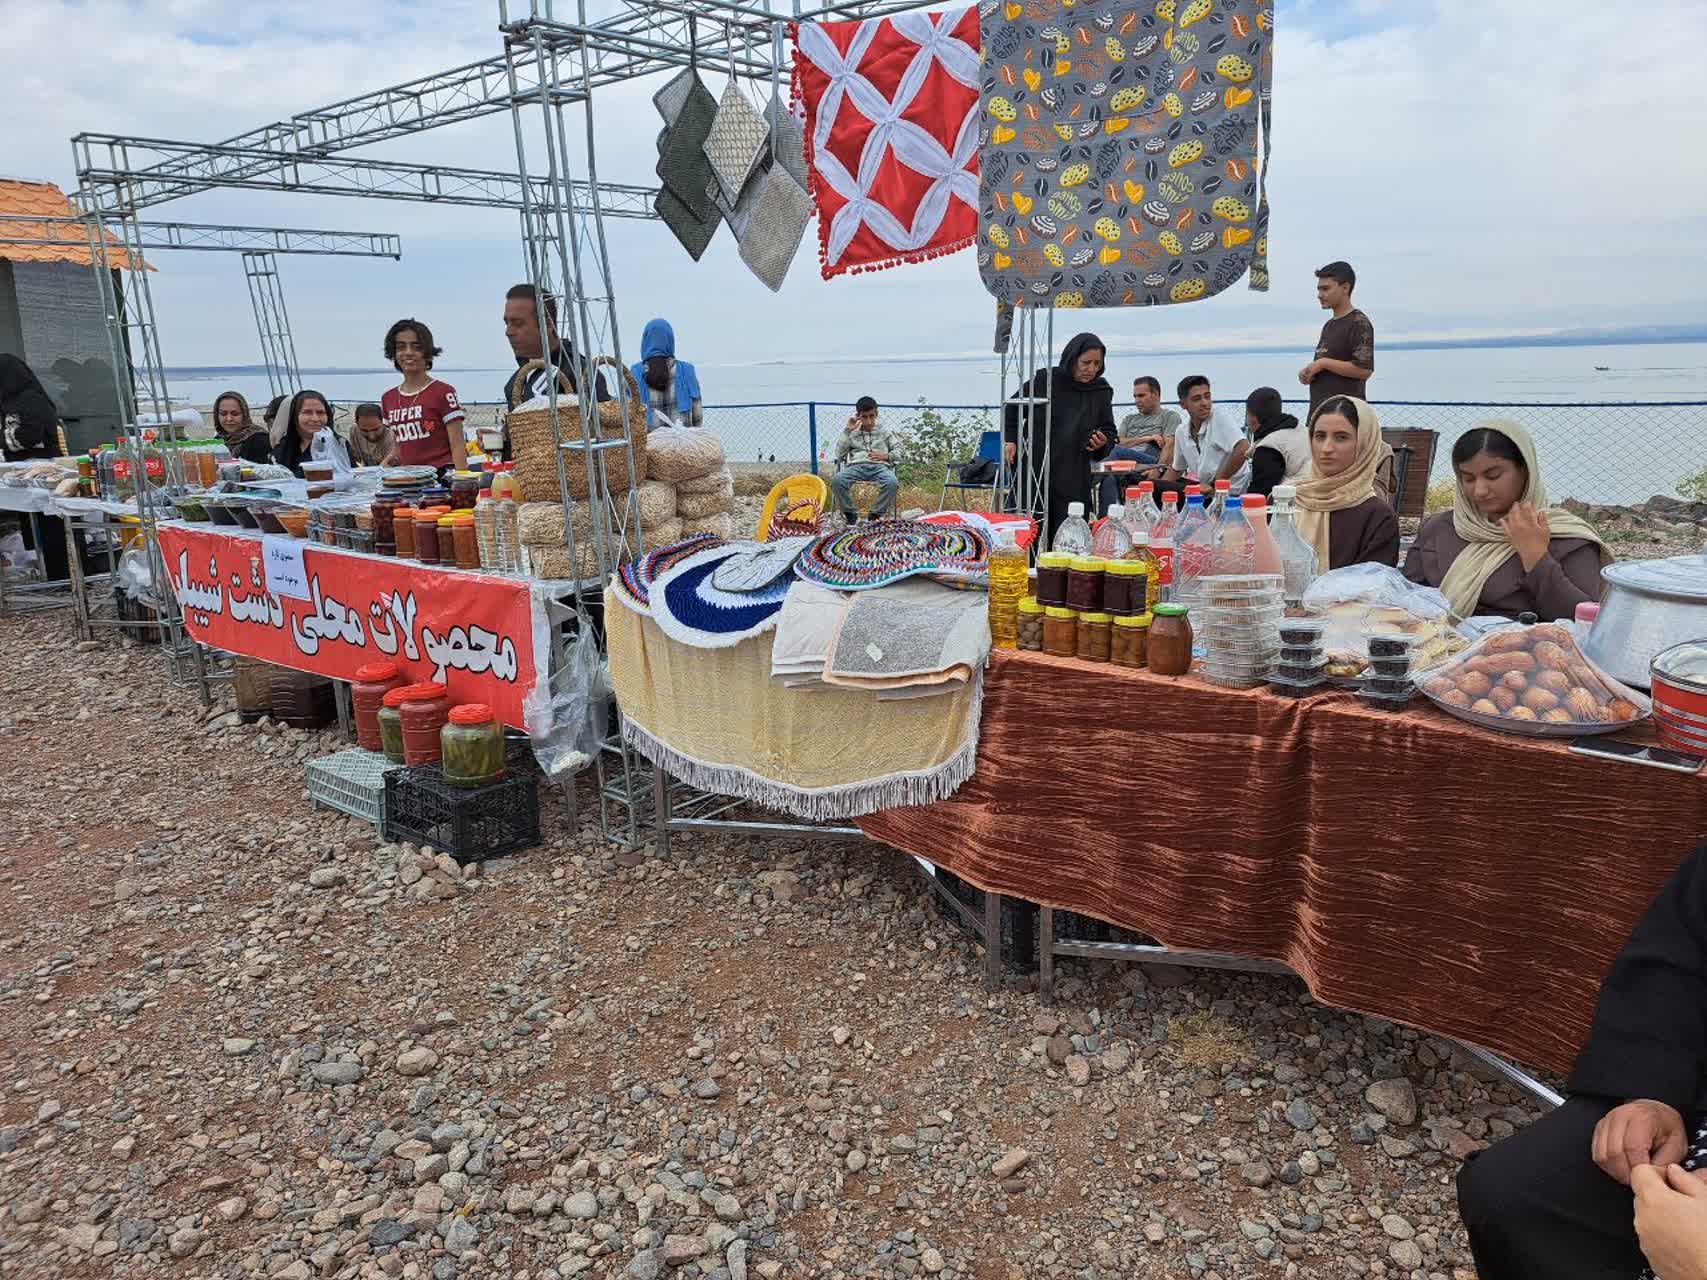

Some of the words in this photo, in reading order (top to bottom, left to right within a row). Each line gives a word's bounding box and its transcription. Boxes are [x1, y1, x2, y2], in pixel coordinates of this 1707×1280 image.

[388, 405, 422, 423] SUPER
[391, 421, 431, 443] COOL
[227, 556, 285, 629] دشت
[290, 571, 367, 656] محلی
[367, 588, 518, 684] محصولات
